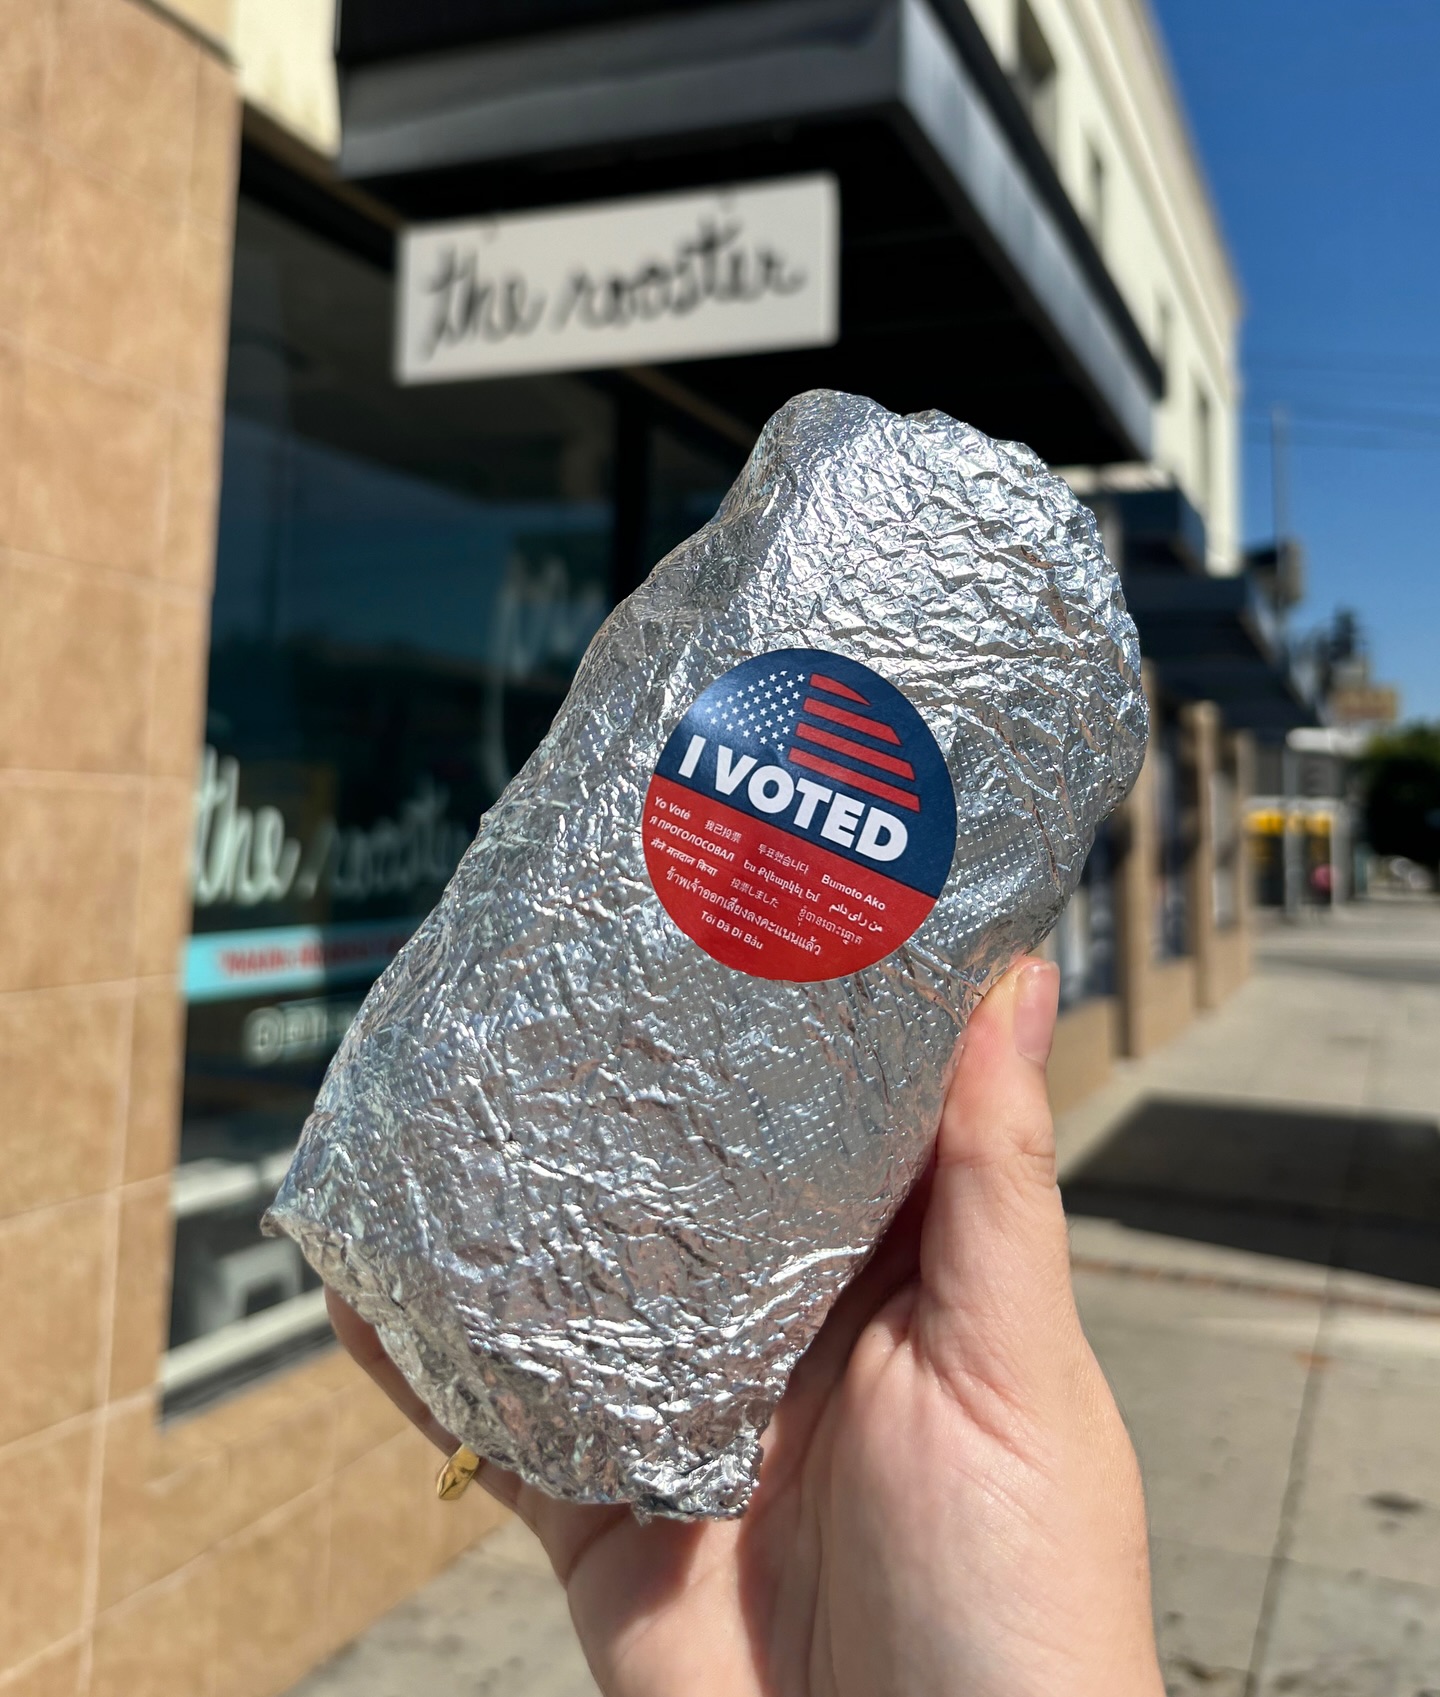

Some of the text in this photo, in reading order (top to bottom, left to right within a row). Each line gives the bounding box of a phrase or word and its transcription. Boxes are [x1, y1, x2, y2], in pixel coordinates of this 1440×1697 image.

[420, 214, 807, 362] the rooster
[655, 796, 691, 820] Yo Voté
[678, 735, 908, 862] I VOTED
[649, 816, 735, 862] Я ПРОГОЛОСОВАЛ
[666, 846, 696, 866] मतदान
[696, 859, 719, 877] किया
[758, 843, 810, 875] 투표했습니다
[730, 877, 780, 909] 投票しました
[821, 874, 886, 911] Bumoto Ako
[731, 926, 742, 939] Đi
